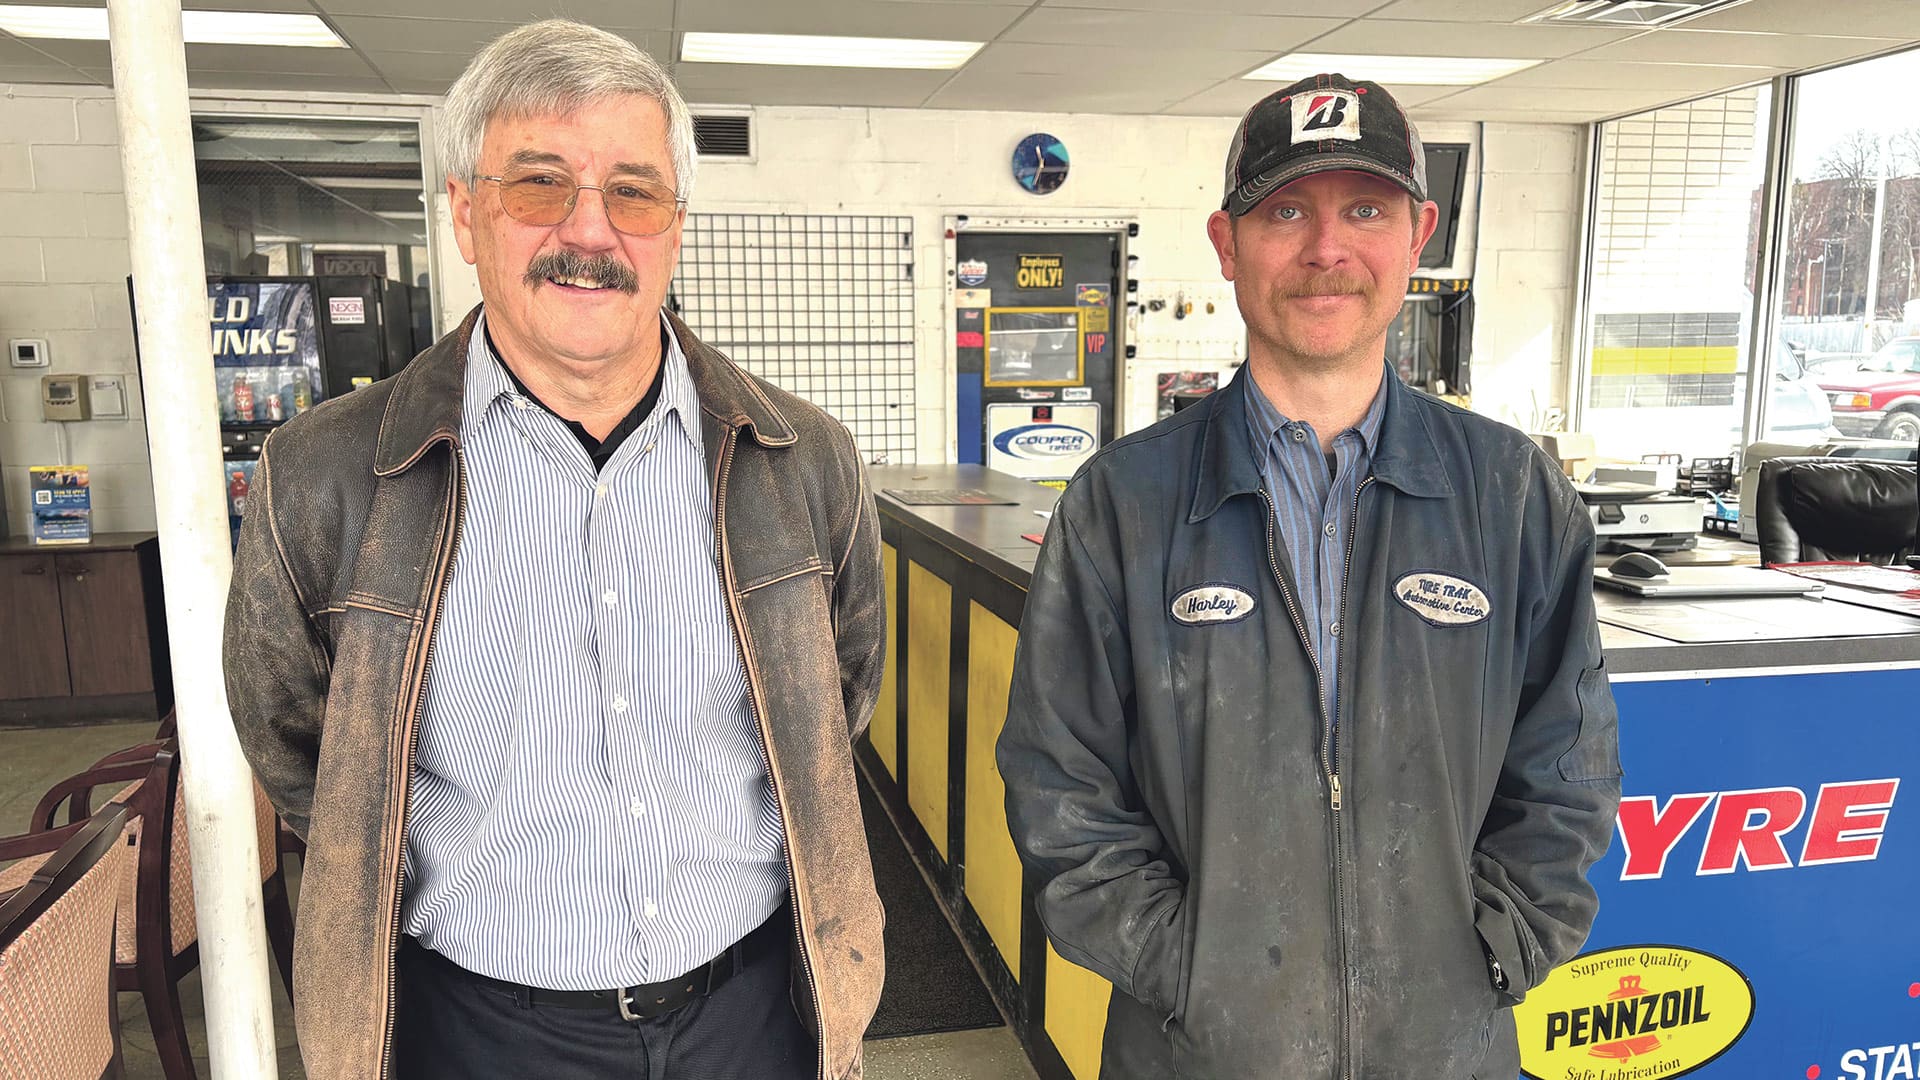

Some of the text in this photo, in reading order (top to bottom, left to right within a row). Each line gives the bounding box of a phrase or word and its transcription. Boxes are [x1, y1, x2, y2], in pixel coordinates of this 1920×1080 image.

[1021, 256, 1060, 268] Employees
[1017, 268, 1064, 287] ONLY!
[331, 303, 363, 312] NEXEN
[1087, 334, 1105, 352] VIP
[1015, 435, 1084, 445] COOPER
[1443, 584, 1473, 600] TRAK
[1187, 595, 1237, 615] Harley
[1403, 589, 1485, 617] Automotive Center
[1570, 951, 1693, 979] Supreme Quality
[1545, 985, 1711, 1052] PENNZOIL
[1565, 1058, 1682, 1080] Safe Lubrication
